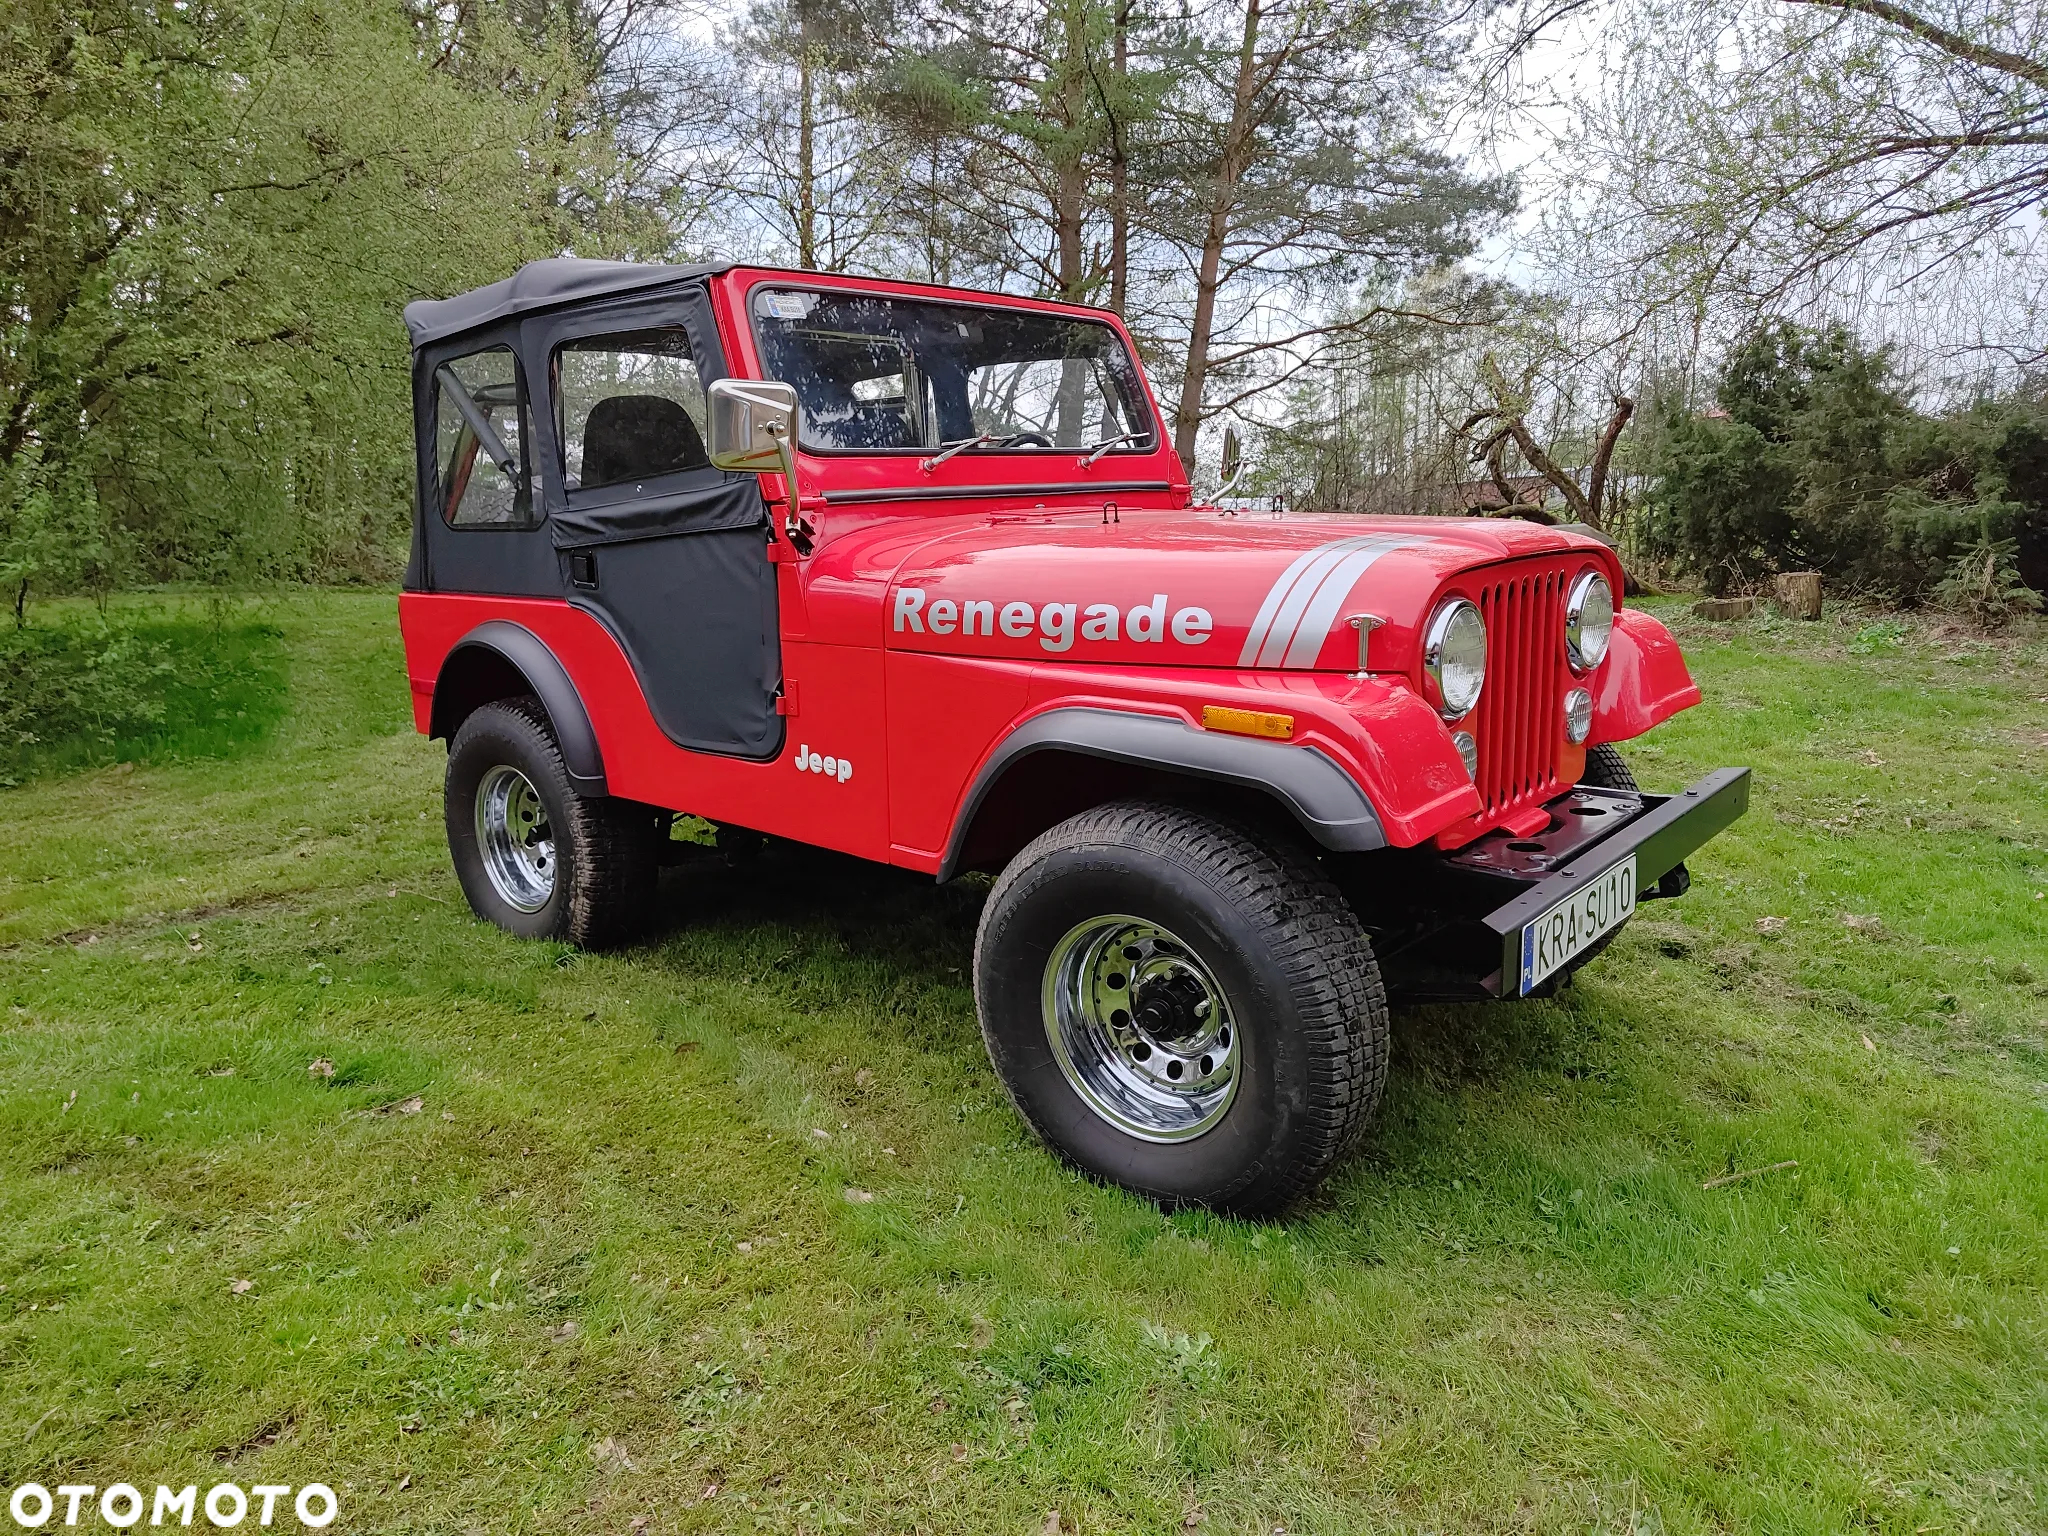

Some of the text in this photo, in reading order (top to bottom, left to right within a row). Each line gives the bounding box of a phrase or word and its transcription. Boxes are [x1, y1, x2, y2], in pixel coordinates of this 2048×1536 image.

[893, 587, 1214, 653] Renegade
[794, 743, 853, 784] Jeep
[1537, 866, 1631, 977] KRA SU10
[1523, 965, 1532, 983] PL
